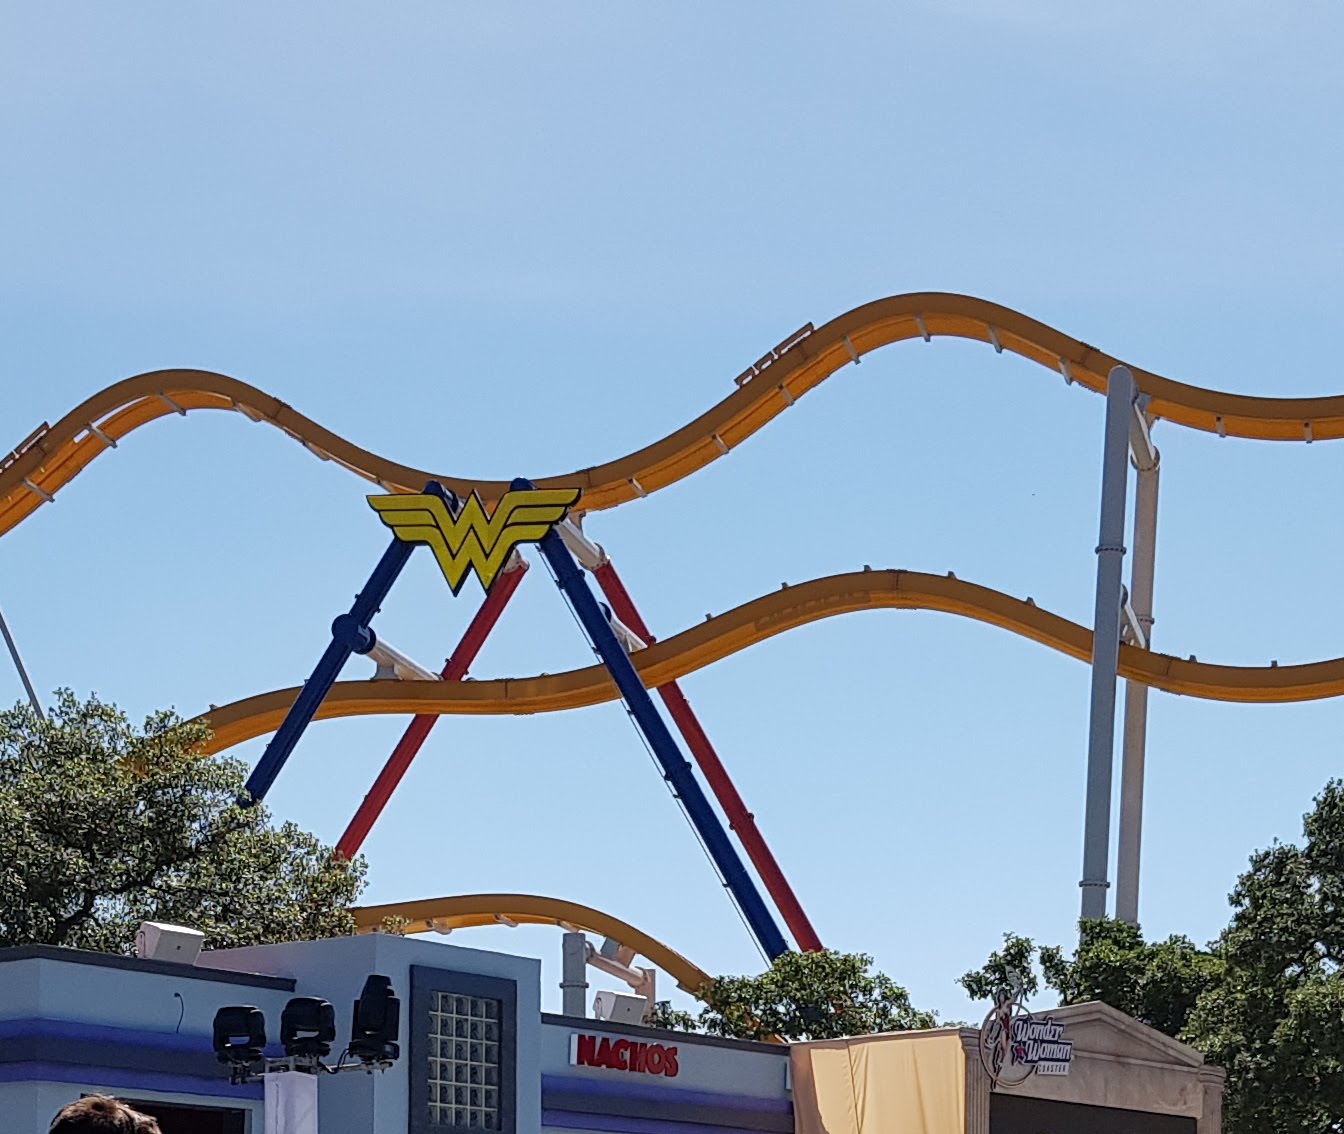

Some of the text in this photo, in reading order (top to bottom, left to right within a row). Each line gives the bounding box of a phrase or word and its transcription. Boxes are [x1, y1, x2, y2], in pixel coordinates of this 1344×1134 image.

[1015, 1018, 1064, 1041] Wonder
[576, 1033, 679, 1077] NACHOS
[1025, 1041, 1072, 1061] Woman
